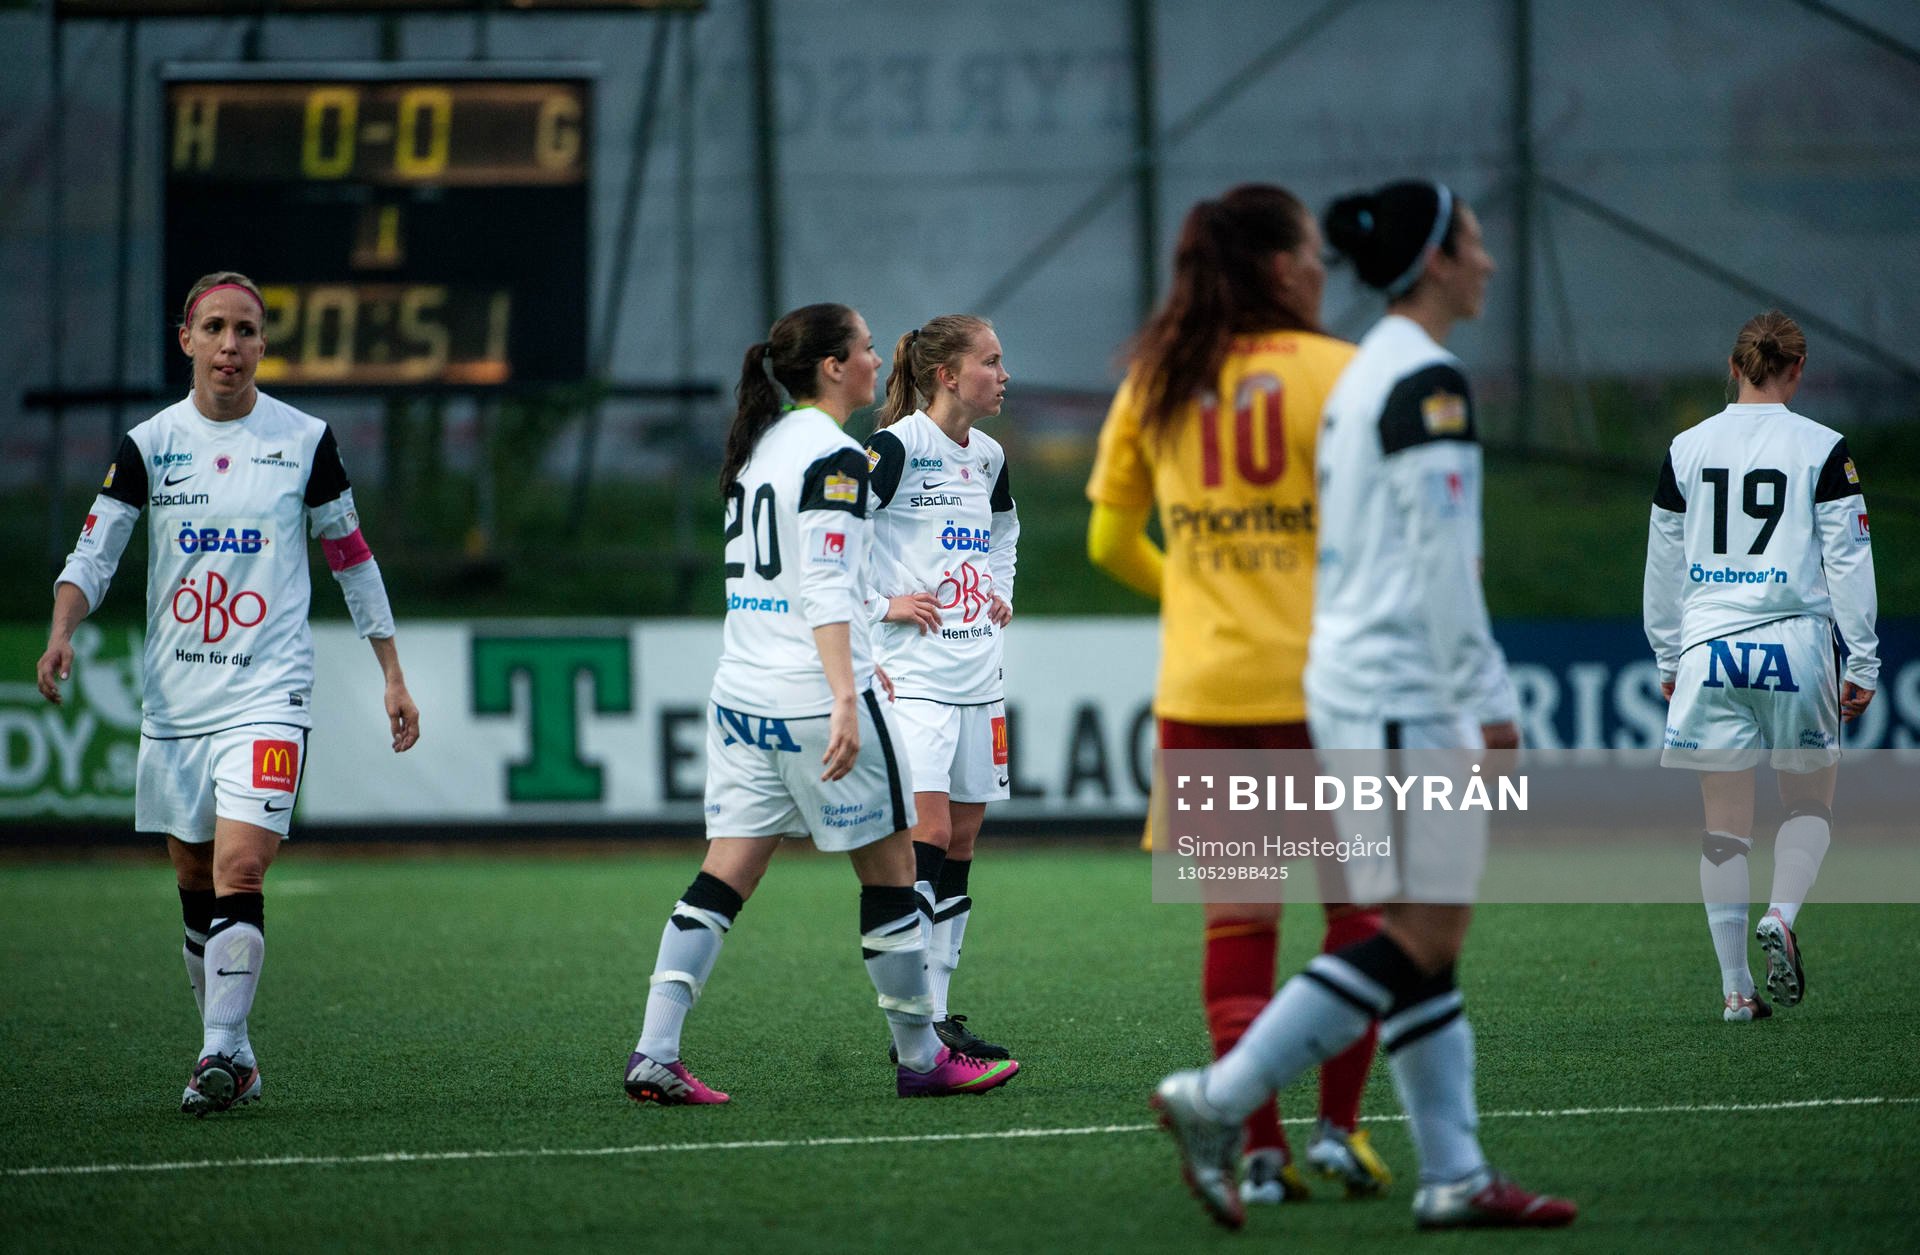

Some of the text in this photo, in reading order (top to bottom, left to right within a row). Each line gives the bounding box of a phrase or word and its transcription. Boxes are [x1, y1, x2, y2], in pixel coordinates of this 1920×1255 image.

[171, 98, 220, 170] H
[1200, 371, 1287, 490] 10
[151, 492, 209, 507] stadium
[910, 494, 963, 508] stadium
[1702, 468, 1787, 555] 19
[178, 521, 262, 554] ÖBAB
[725, 481, 782, 581] 20
[941, 520, 991, 553] ÖBAB
[172, 571, 267, 644] ÖBO
[942, 628, 969, 640] Hem
[175, 648, 252, 668] Hem för dig
[1703, 639, 1800, 692] NA
[716, 705, 802, 752] NA
